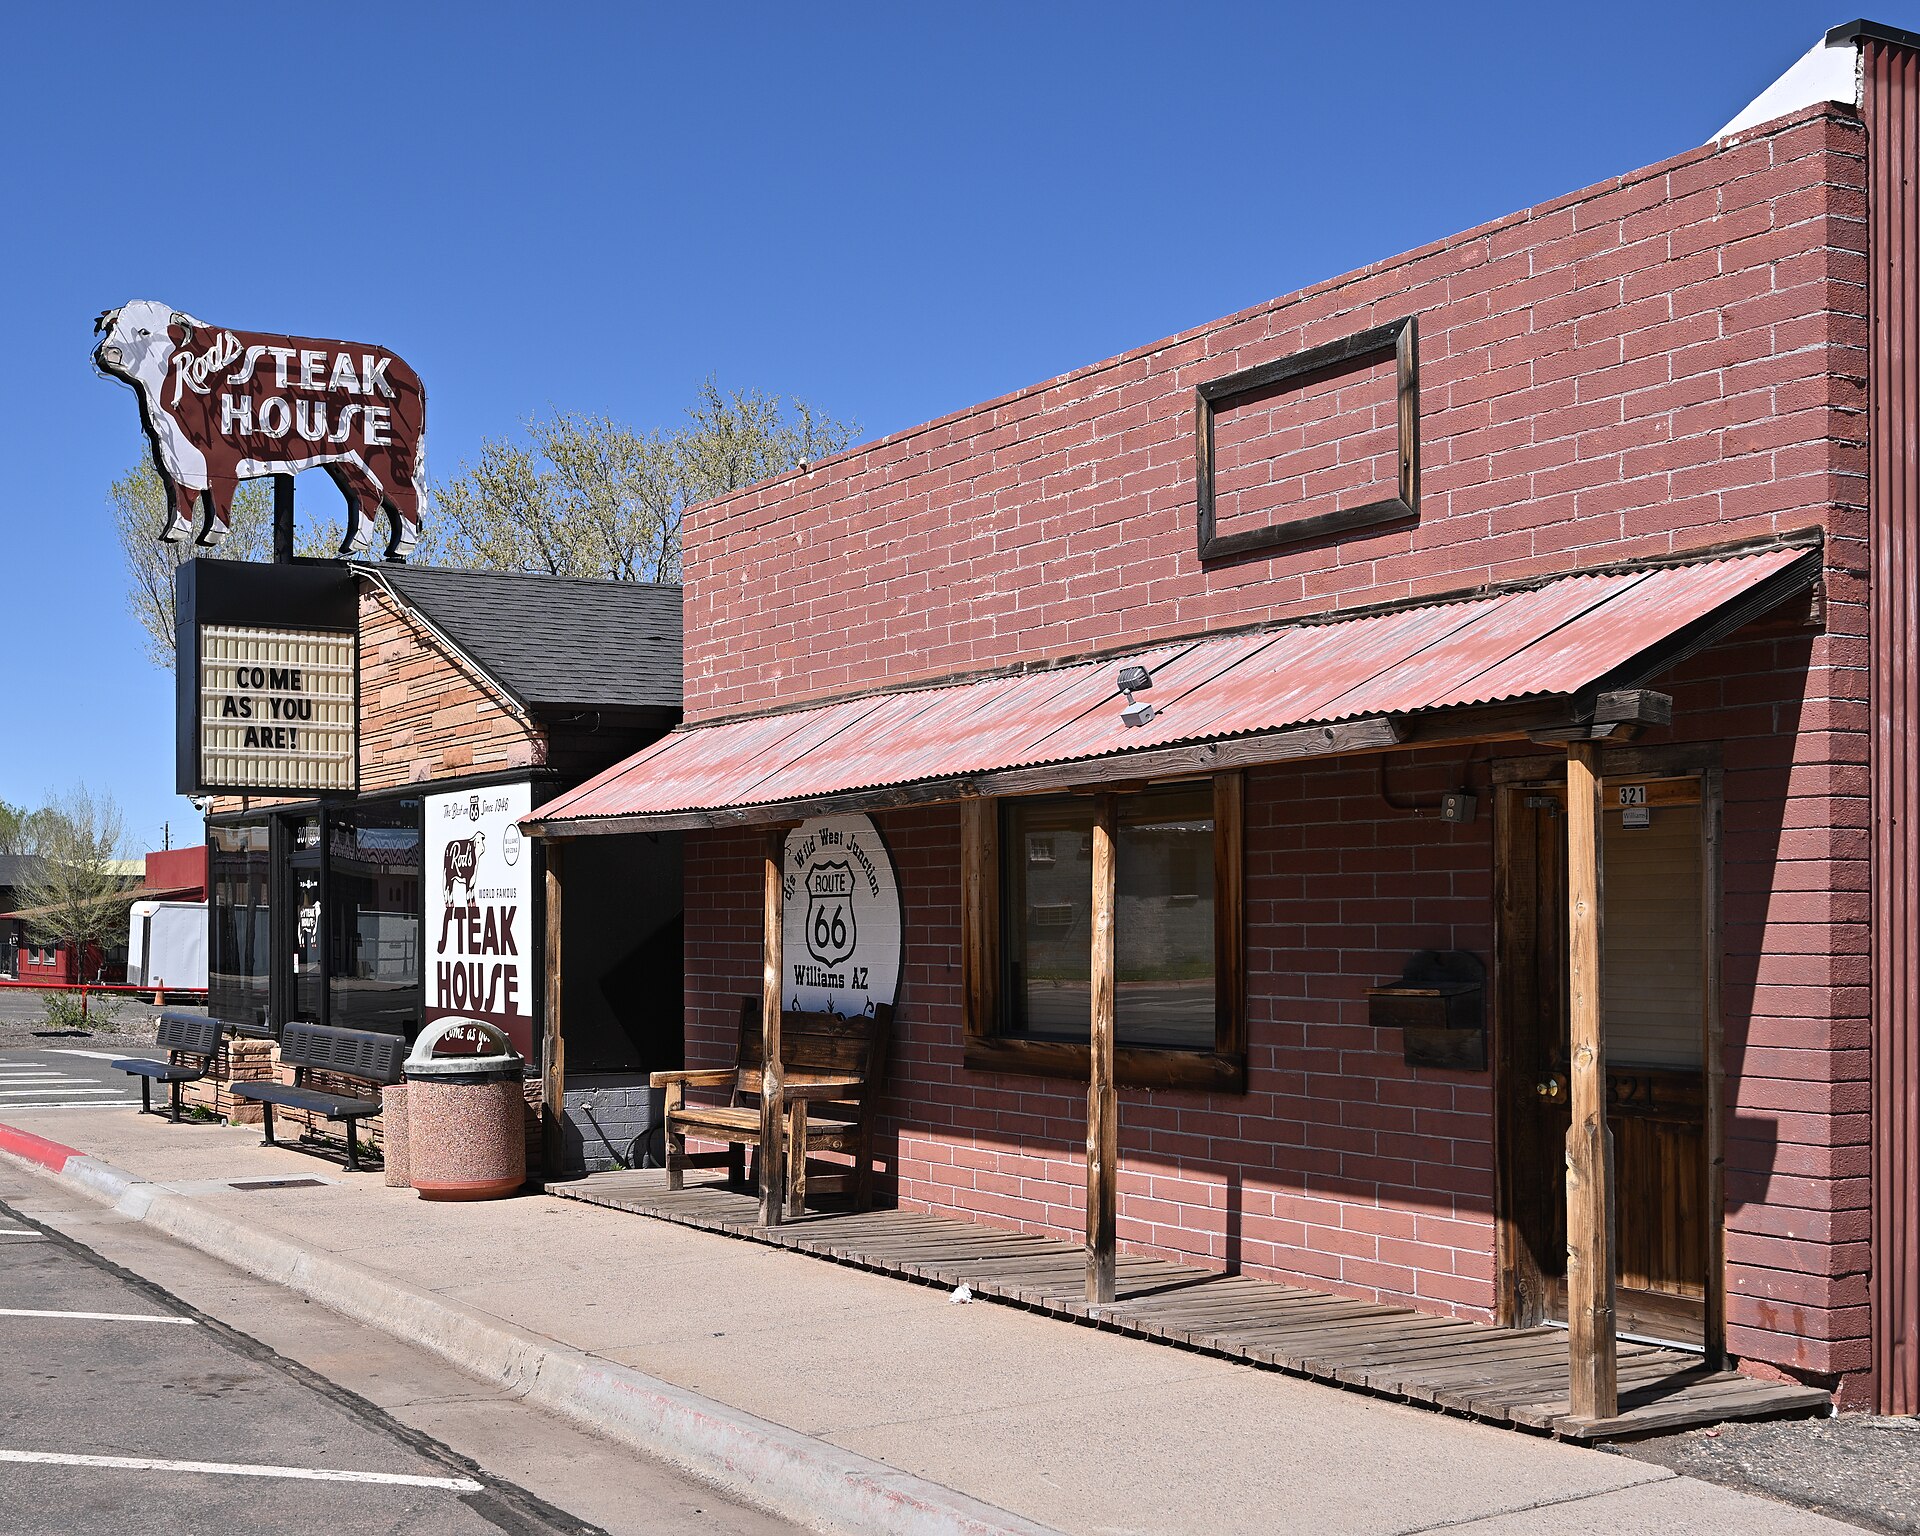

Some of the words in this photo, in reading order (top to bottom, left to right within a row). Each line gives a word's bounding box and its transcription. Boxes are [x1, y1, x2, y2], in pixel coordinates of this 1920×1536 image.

[227, 345, 397, 399] STEAK
[221, 393, 392, 446] HOUSE
[237, 666, 302, 691] COME
[222, 695, 252, 718] AS
[270, 697, 312, 721] YOU
[244, 726, 297, 749] ARE!
[481, 799, 494, 815] Since
[495, 797, 509, 812] 1946
[1620, 787, 1644, 804] 321
[450, 841, 472, 876] Rod's
[794, 835, 816, 869] Wild
[819, 828, 844, 846] West
[846, 833, 879, 898] Junction
[479, 888, 495, 899] WORLD
[496, 887, 516, 899] FAMOUS
[815, 873, 846, 893] ROUTE
[437, 906, 518, 956] STEAK
[815, 904, 846, 949] 66
[437, 961, 518, 1015] HOUSE
[794, 964, 845, 989] Williams
[852, 967, 868, 990] AZ
